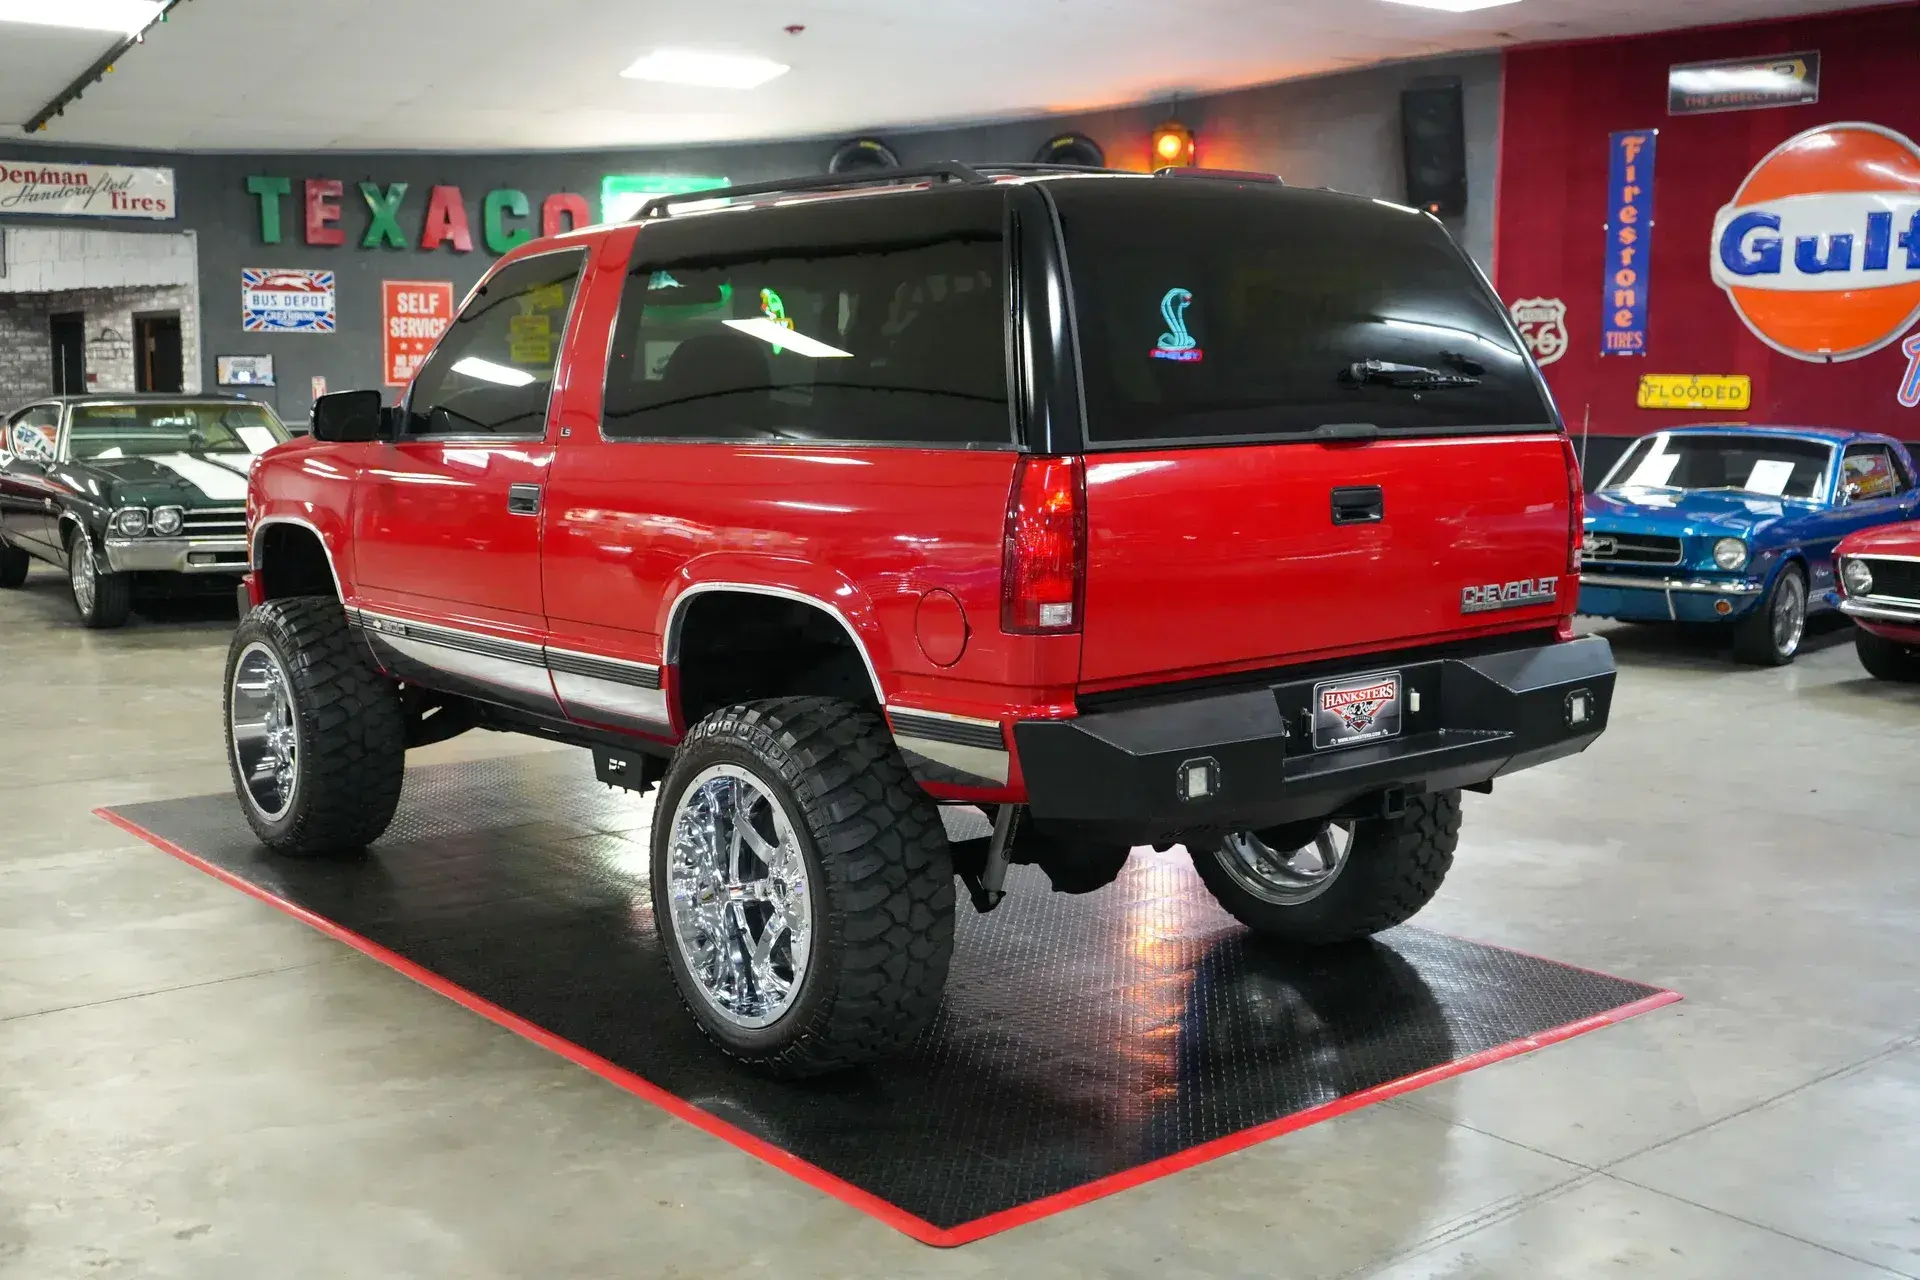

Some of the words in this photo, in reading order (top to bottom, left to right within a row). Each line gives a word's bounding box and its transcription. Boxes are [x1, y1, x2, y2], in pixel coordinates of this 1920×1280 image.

[1, 168, 134, 210] Handcrafted
[109, 191, 166, 212] Tires
[1613, 135, 1647, 328] Firestone
[252, 294, 278, 306] BUS
[284, 295, 327, 307] DEPOT
[397, 292, 440, 315] SELF
[1606, 330, 1643, 349] TIRES
[1647, 384, 1742, 400] FLOODED
[1462, 576, 1559, 605] CHEVROLET
[1325, 684, 1394, 708] HANKSTERS
